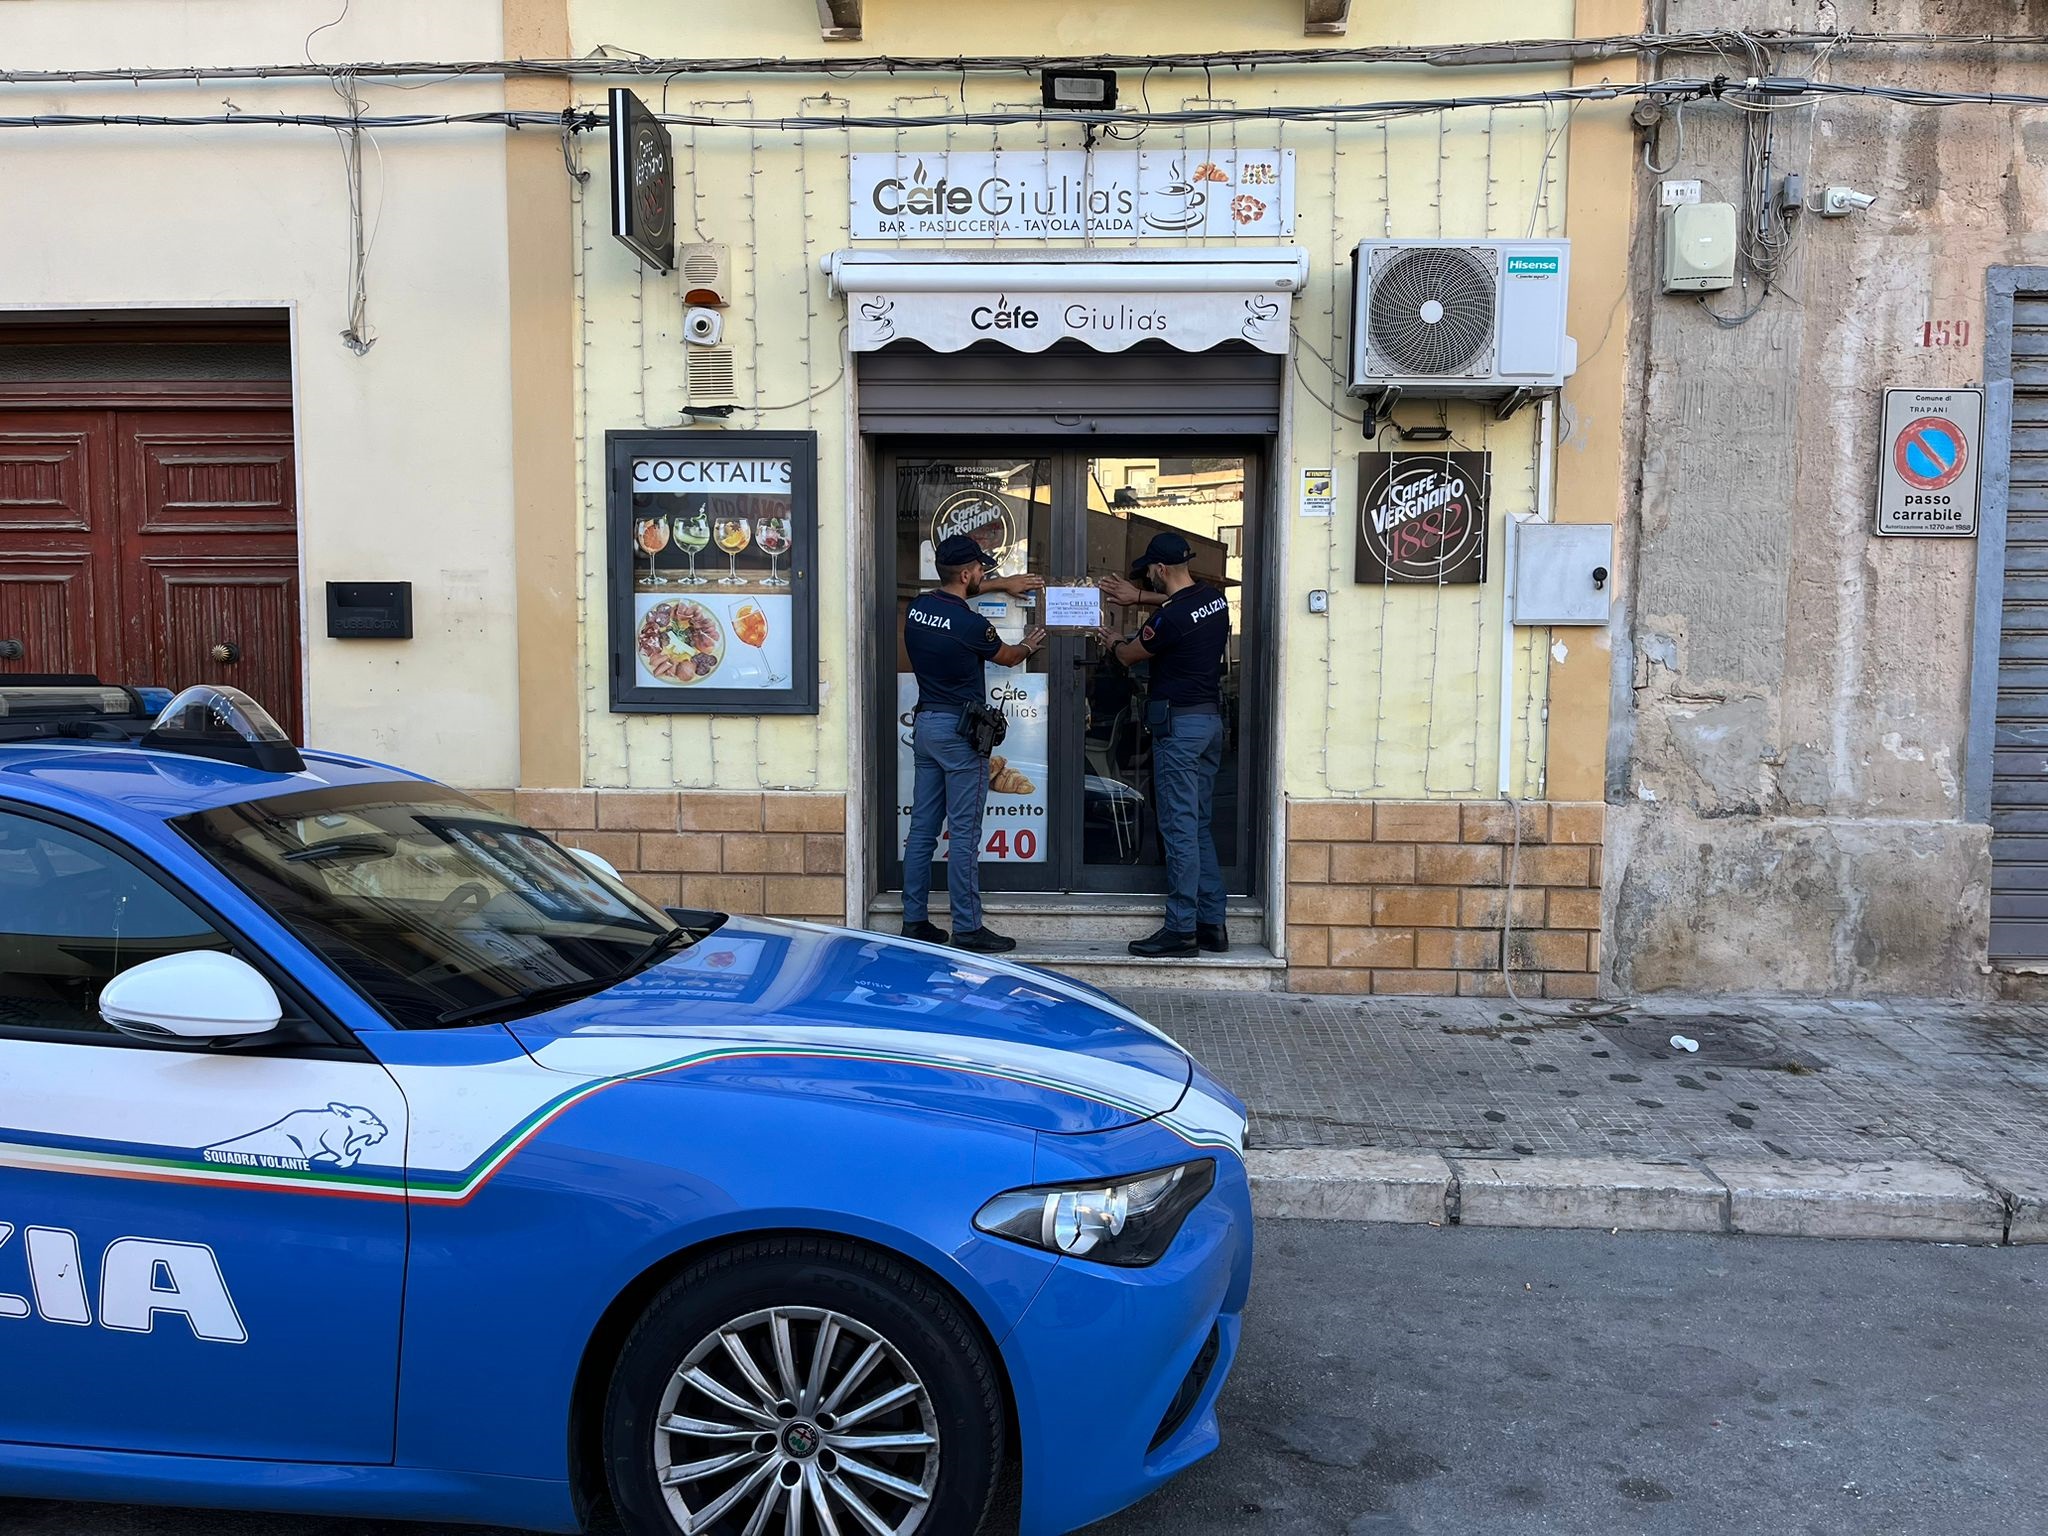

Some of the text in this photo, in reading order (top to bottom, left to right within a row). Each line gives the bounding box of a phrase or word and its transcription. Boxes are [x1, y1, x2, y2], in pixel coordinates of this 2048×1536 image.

[977, 175, 1133, 216] Giulia's
[879, 220, 906, 233] BAR
[919, 220, 1011, 233] PASTICCERIA
[1023, 219, 1080, 232] TAVOLA
[1509, 260, 1557, 270] Hisense
[971, 303, 1168, 332] Cafe Giulia's
[1922, 319, 1971, 348] 159
[1915, 394, 1952, 402] Comune di
[633, 460, 792, 484] COCKTAIL'S
[1370, 478, 1465, 534] VERGNANO
[1904, 494, 1951, 506] passo
[936, 505, 1001, 542] VERGNANO
[1892, 508, 1962, 521] carrabile
[1391, 503, 1463, 565] 1882
[908, 608, 951, 630] POLIZIA
[1190, 597, 1227, 623] POLIZIA
[203, 1149, 311, 1171] SQUADRA VOLANTE
